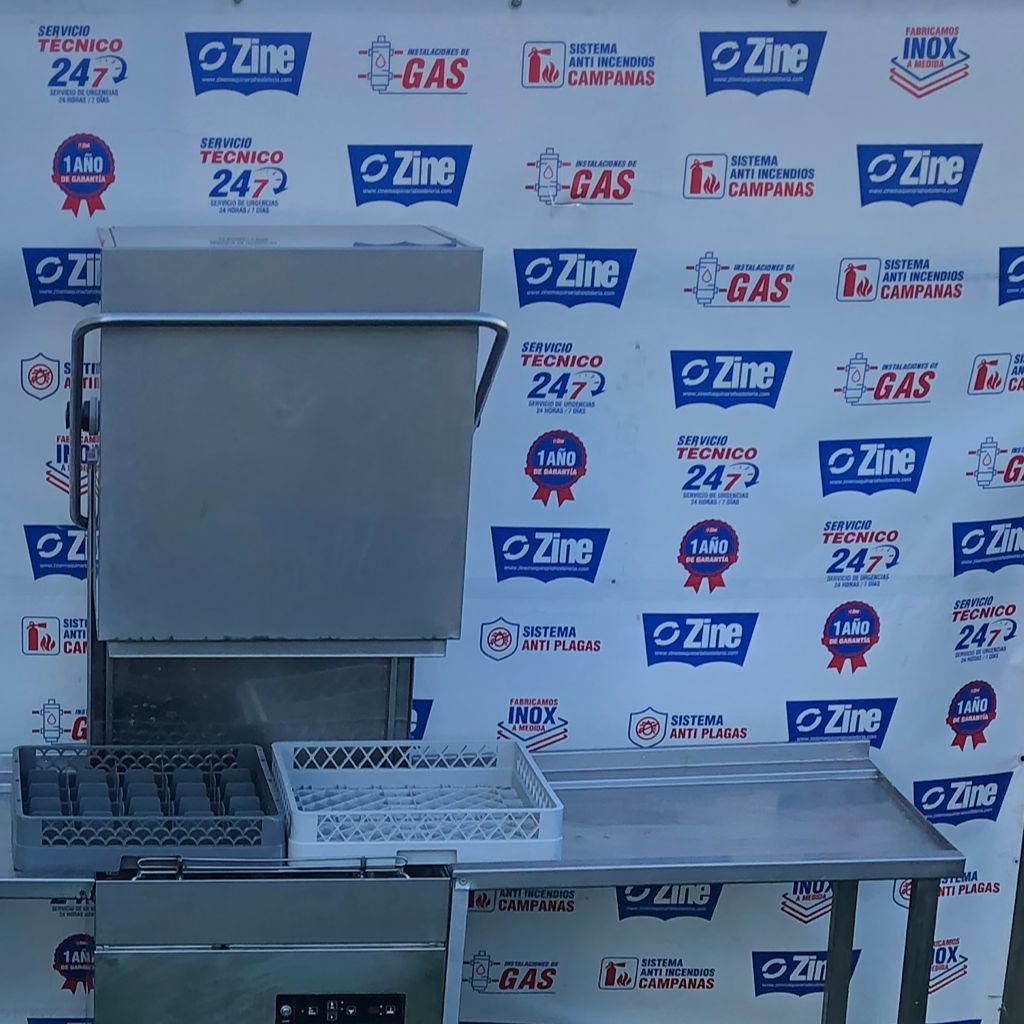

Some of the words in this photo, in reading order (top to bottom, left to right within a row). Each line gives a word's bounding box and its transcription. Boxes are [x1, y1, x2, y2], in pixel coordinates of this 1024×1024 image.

[37, 25, 90, 37] SERVICIO
[905, 26, 959, 36] FABRICAMOS
[232, 37, 295, 74] Zine
[569, 43, 617, 55] SISTEMA
[744, 37, 809, 74] Zine
[903, 36, 959, 60] INOX
[568, 56, 594, 68] ANTI
[597, 56, 655, 68] INCENDIOS
[913, 60, 945, 69] MEDIDA
[402, 57, 468, 90] GAS
[568, 70, 655, 86] CAMPANAS
[393, 150, 456, 186] Zine
[731, 155, 778, 167] SISTEMA
[899, 150, 964, 185] Zine
[729, 168, 755, 180] ANTI
[757, 168, 815, 180] INCENDIOS
[570, 169, 635, 203] GAS
[728, 181, 814, 197] CAMPANAS
[556, 253, 619, 288] Zine
[884, 259, 930, 270] SISTEMA
[882, 271, 907, 283] ANTI
[909, 270, 964, 282] INCENDIOS
[726, 272, 793, 303] GAS
[880, 283, 963, 299] CAMPANAS
[521, 341, 573, 353] SERVICIO
[712, 356, 775, 389] Zine
[873, 370, 936, 401] GAS
[857, 443, 916, 476] Zine
[533, 532, 593, 564] Zine
[683, 618, 743, 648] Zine
[510, 698, 559, 706] FABRICAMOS
[508, 706, 558, 725] INOX
[827, 704, 881, 734] Zine
[518, 724, 546, 732] MEDIDA
[949, 781, 998, 810] Zine
[958, 880, 1001, 896] PLAGAS
[498, 898, 576, 913] CAMPANAS
[498, 967, 557, 990] GAS
